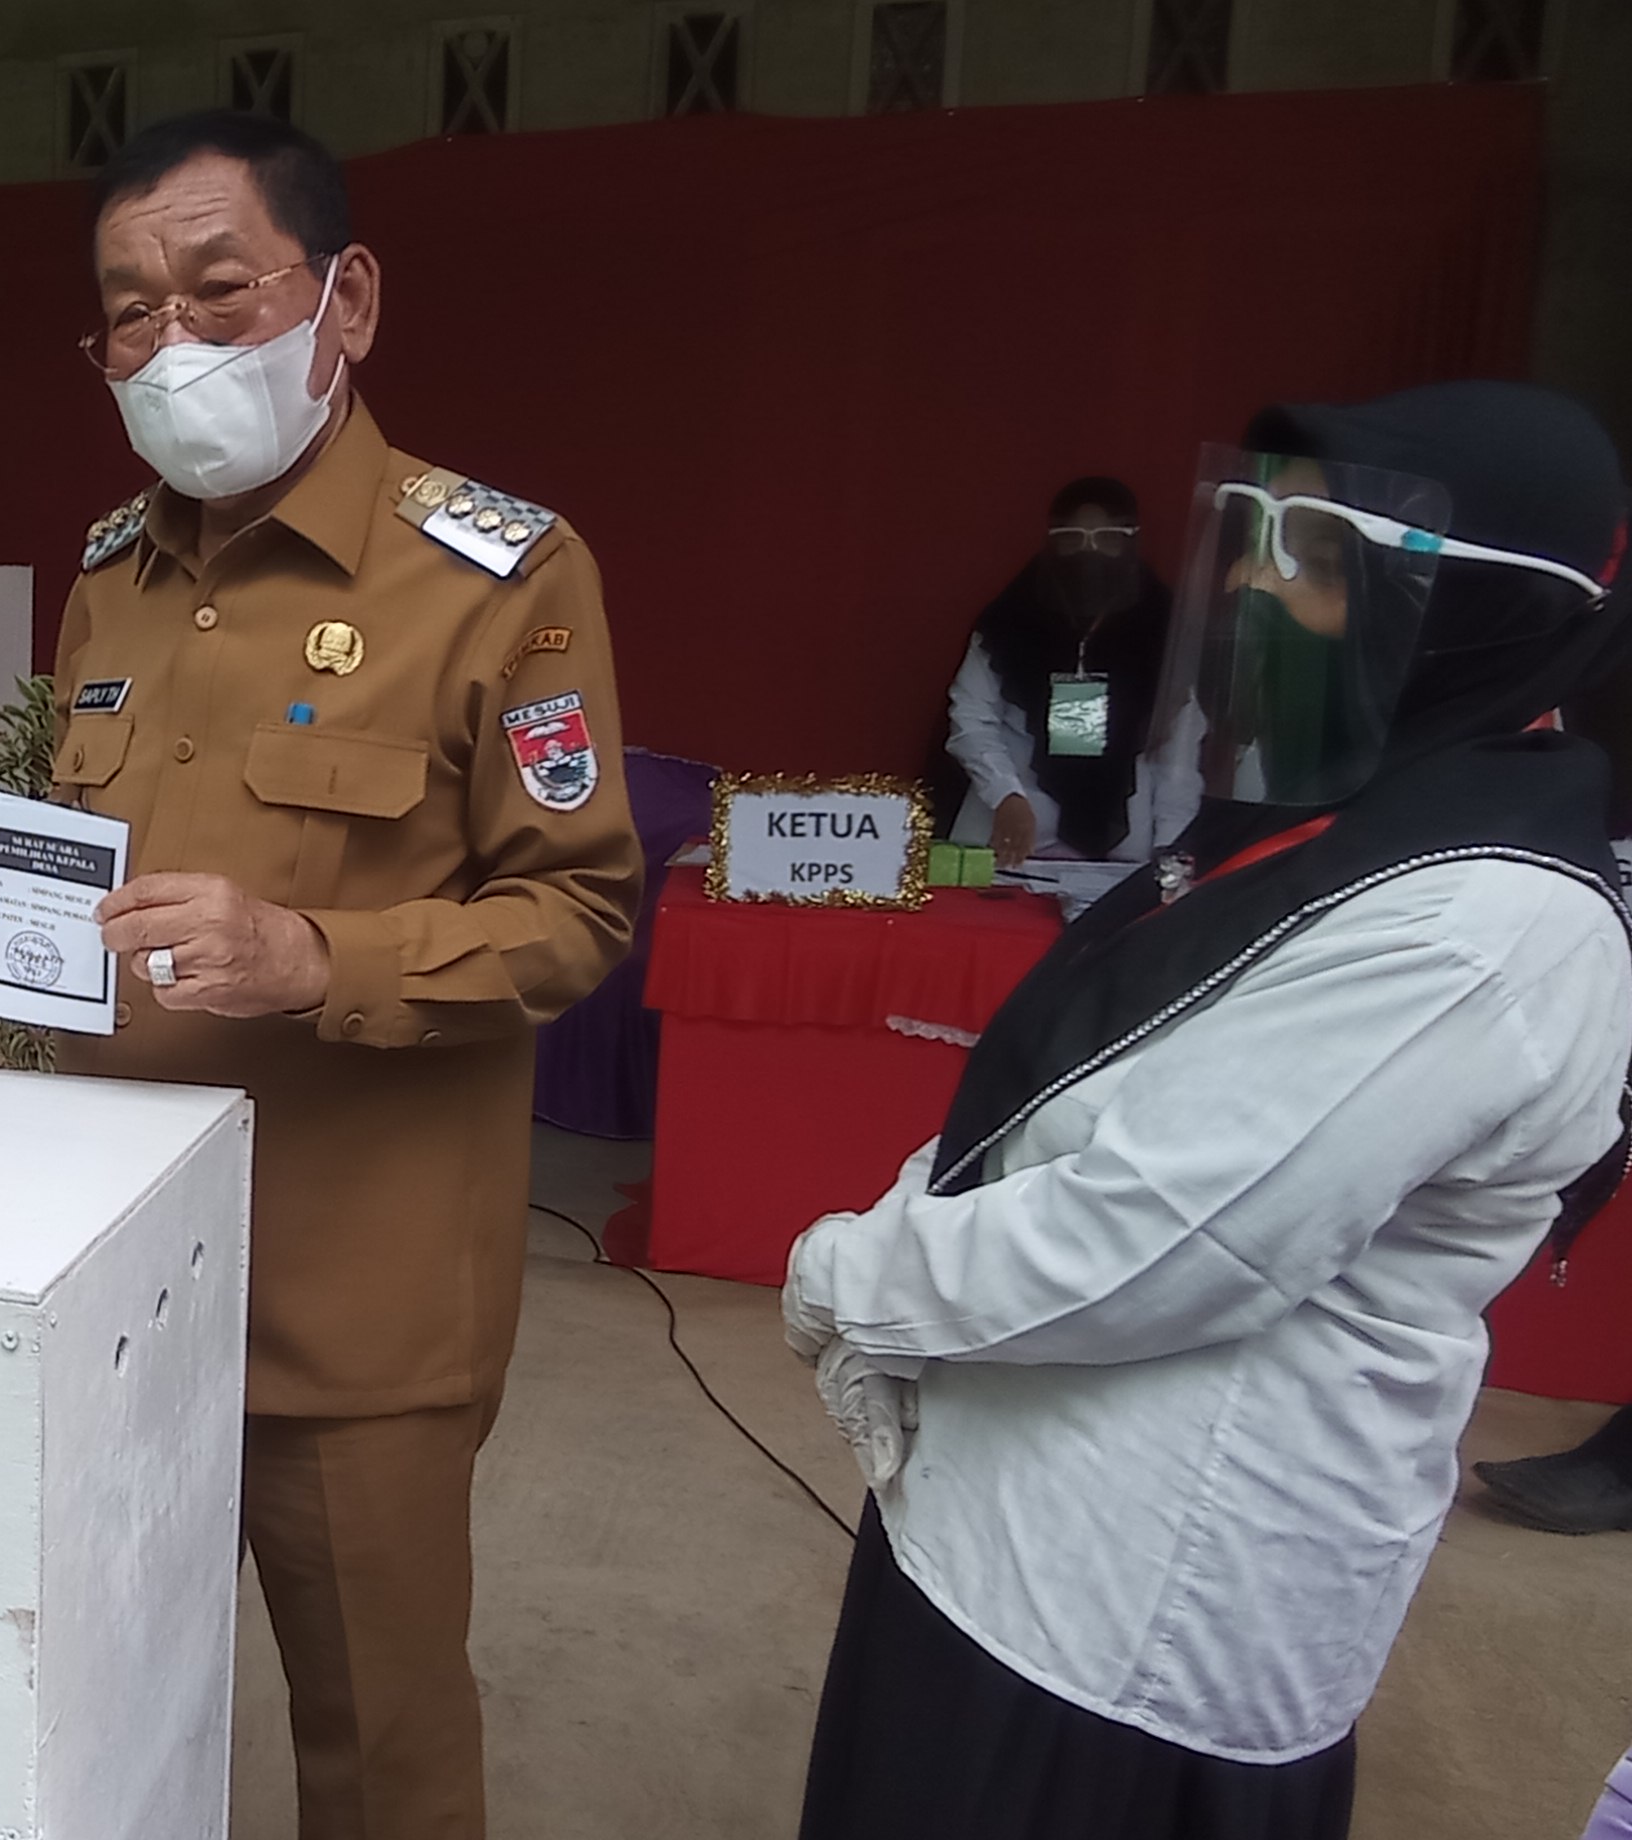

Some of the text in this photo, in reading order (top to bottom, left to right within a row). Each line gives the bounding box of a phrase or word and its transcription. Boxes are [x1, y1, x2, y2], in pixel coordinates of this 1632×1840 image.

[506, 697, 575, 724] MESUJI
[768, 812, 880, 840] KETUA
[11, 836, 79, 857] SURAT SUARA
[32, 860, 59, 874] DESA
[56, 854, 96, 871] KEPALA
[789, 862, 854, 884] KPPS
